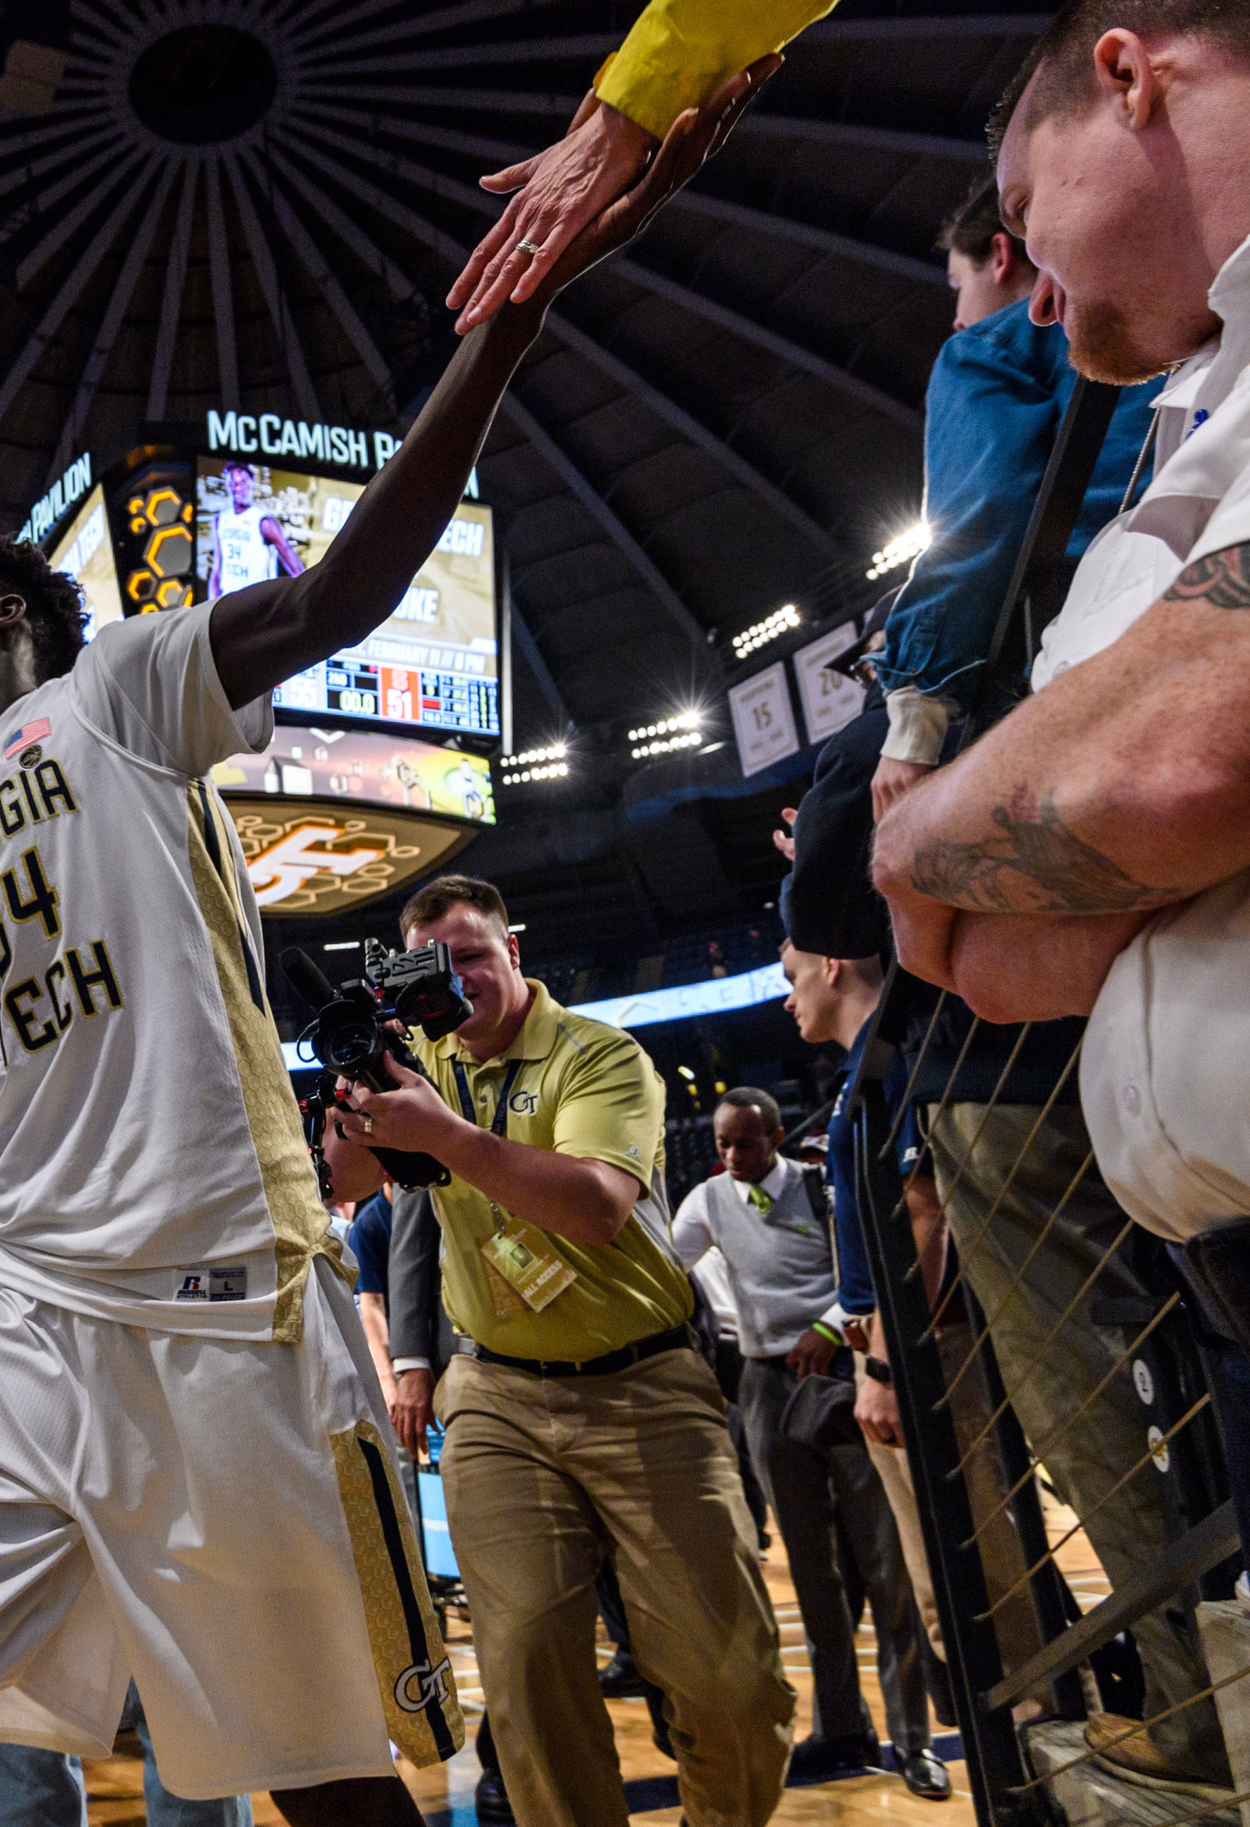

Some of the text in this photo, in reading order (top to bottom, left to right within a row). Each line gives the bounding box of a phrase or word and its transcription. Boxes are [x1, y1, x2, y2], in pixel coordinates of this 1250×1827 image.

[30, 451, 93, 544] PAVILION
[437, 519, 485, 557] ECH
[393, 586, 440, 625] UKE
[340, 690, 375, 714] 00.0
[387, 688, 413, 721] 51
[752, 702, 773, 731] 15
[509, 1091, 538, 1114] GT
[223, 1280, 233, 1291] L
[523, 1283, 539, 1298] ALL
[394, 1657, 451, 1713] GT
